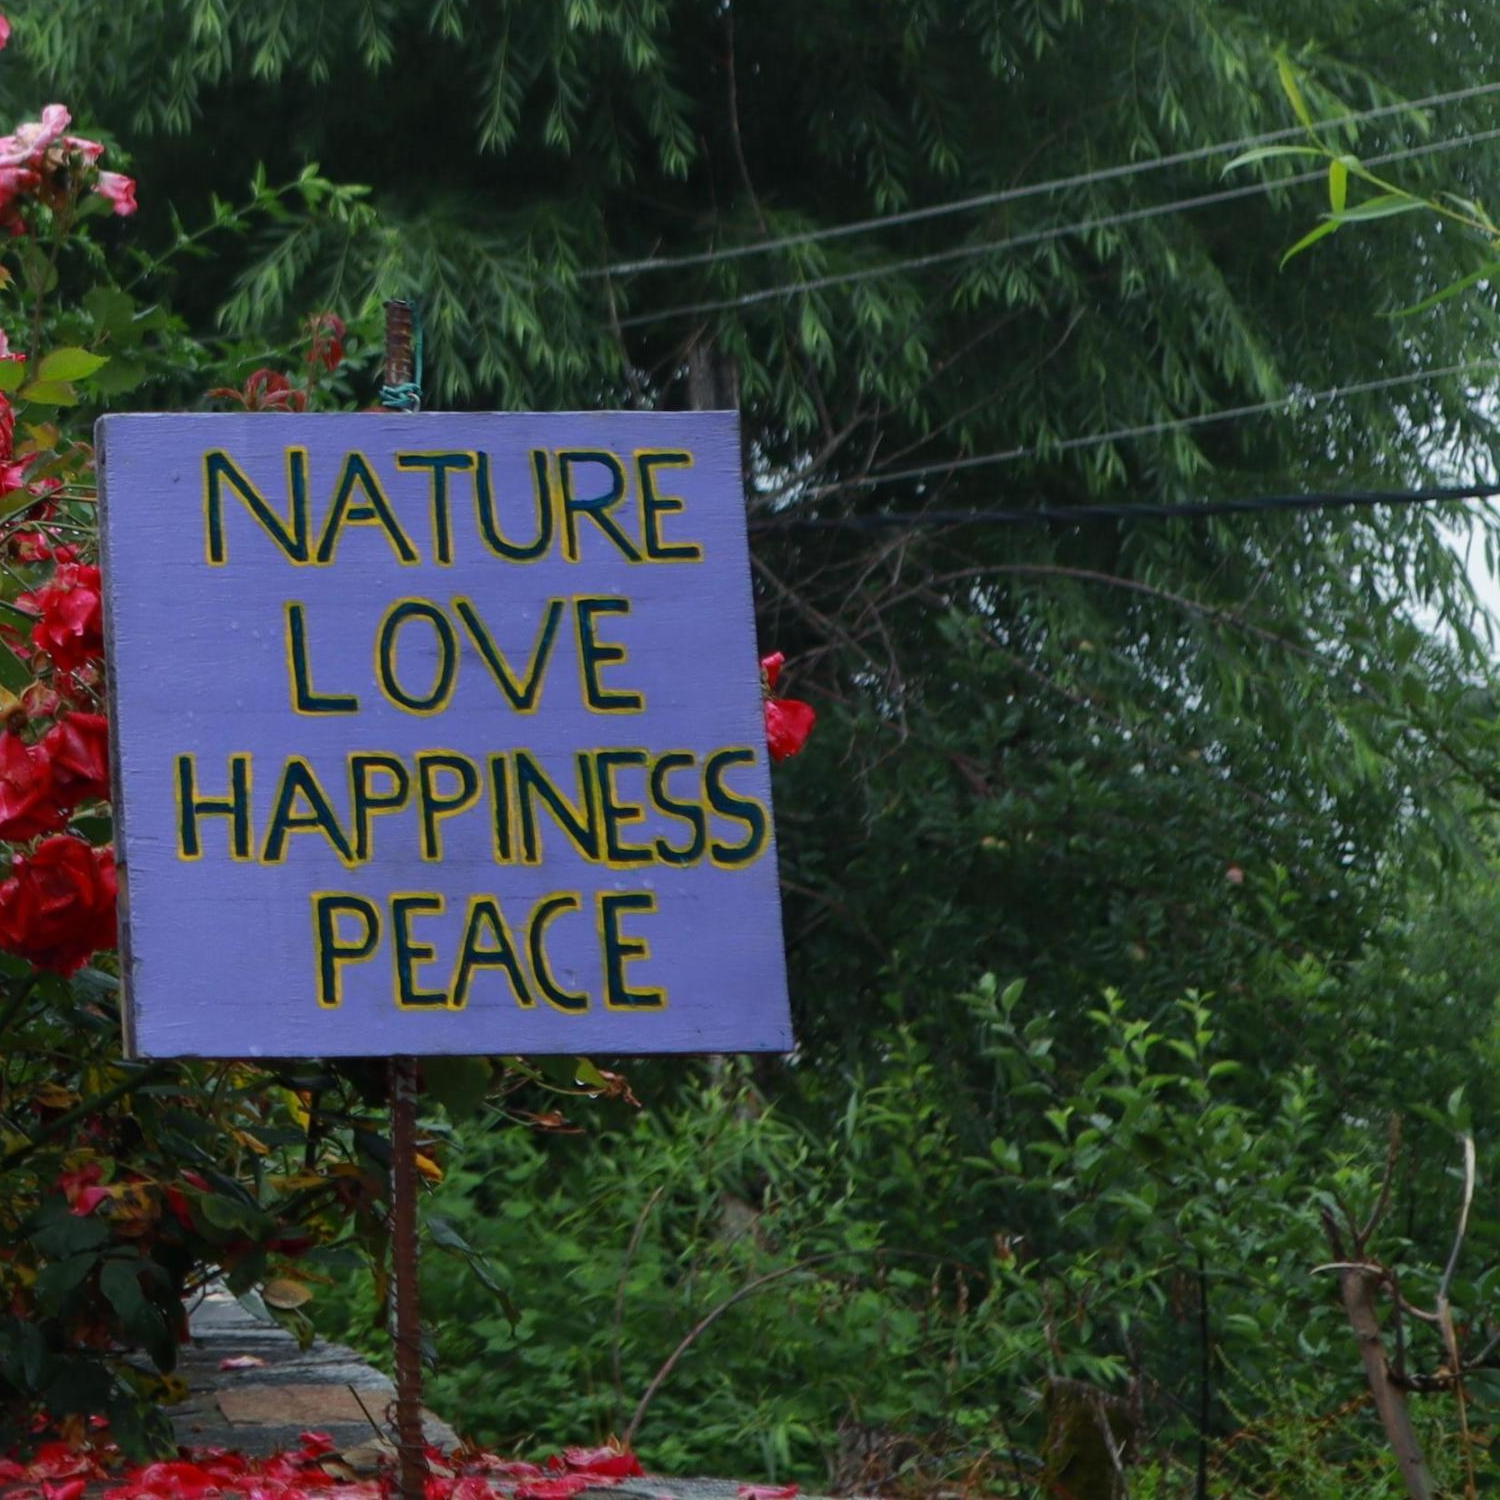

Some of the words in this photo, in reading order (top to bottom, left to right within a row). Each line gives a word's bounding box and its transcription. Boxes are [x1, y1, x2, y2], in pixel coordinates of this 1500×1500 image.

[205, 445, 701, 564] NATURE
[285, 595, 647, 714] LOVE
[174, 748, 772, 868] HAPPINESS
[311, 891, 667, 1010] PEACE
